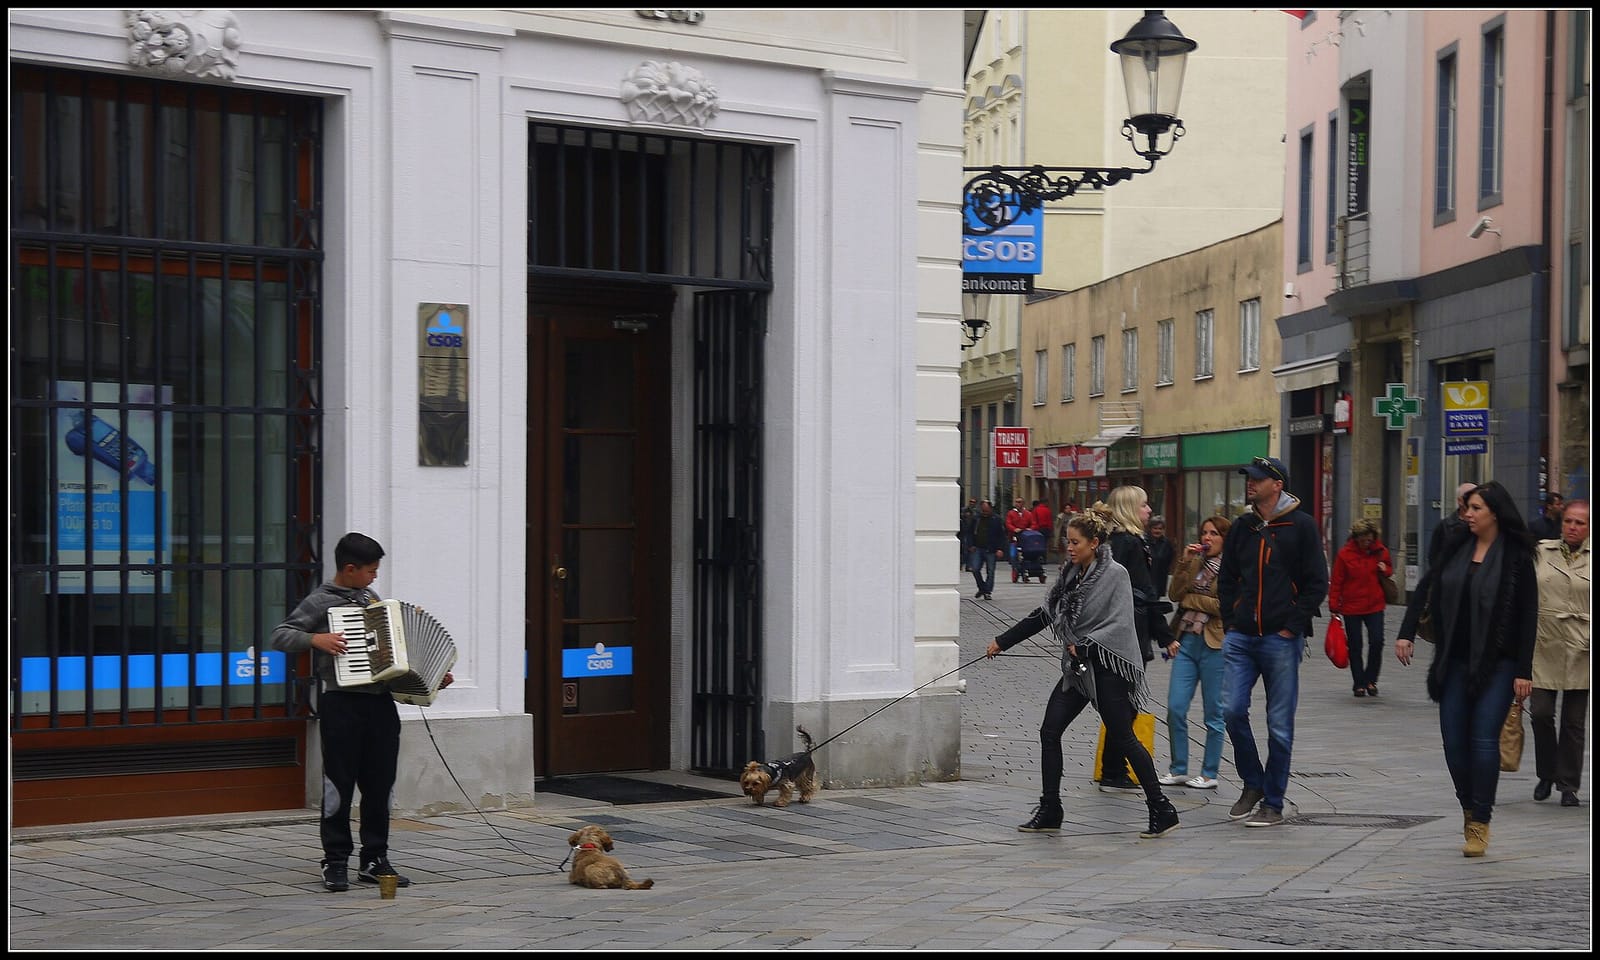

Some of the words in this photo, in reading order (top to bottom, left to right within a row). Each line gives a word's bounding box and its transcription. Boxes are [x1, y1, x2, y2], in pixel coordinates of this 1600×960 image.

[1349, 132, 1358, 213] architekti
[963, 238, 1035, 262] ČSOB
[962, 276, 1027, 291] ankomat
[427, 333, 462, 347] ČSOB
[998, 432, 1026, 446] TRAFIKA
[1003, 449, 1021, 464] TLAČ
[236, 665, 270, 677] ČSB
[587, 659, 614, 670] ČSOB
